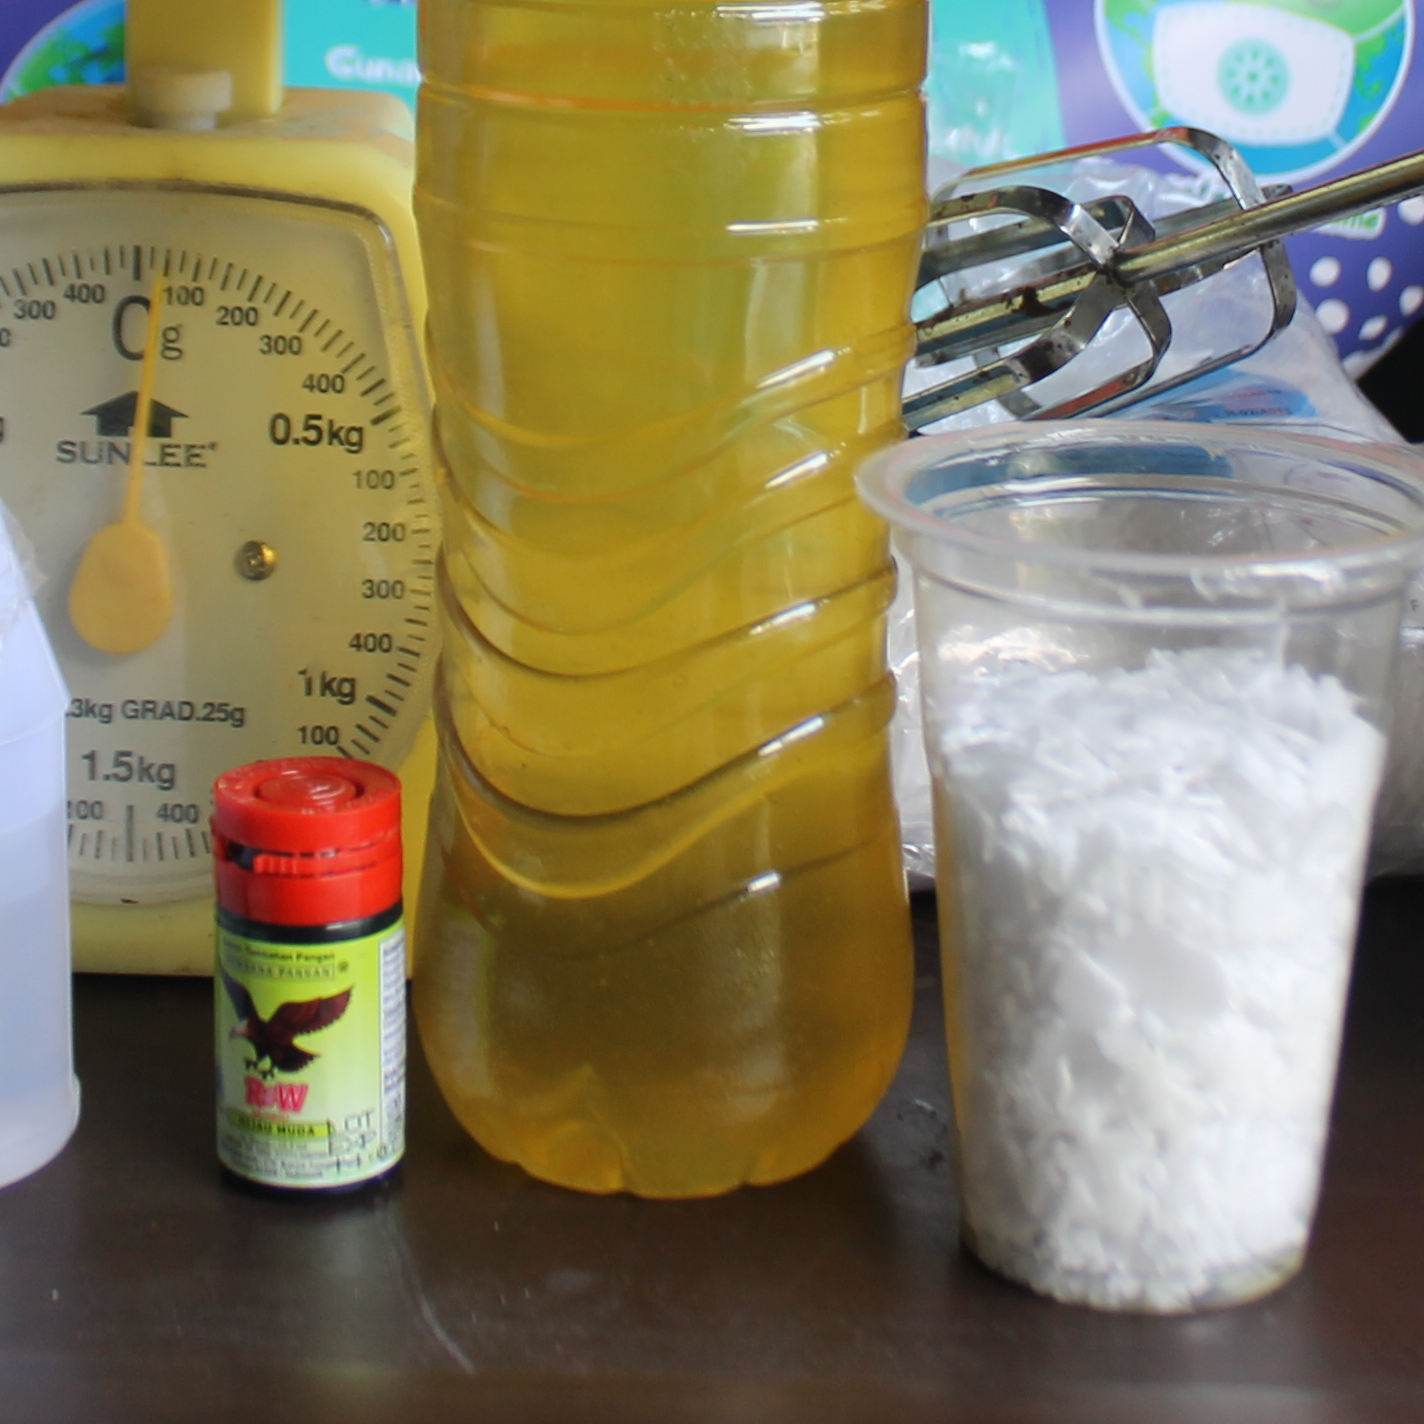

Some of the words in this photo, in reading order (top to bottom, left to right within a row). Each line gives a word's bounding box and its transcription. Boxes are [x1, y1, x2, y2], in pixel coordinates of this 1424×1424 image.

[63, 282, 106, 304] 400
[163, 284, 206, 307] 100
[13, 299, 56, 321] 300
[215, 305, 260, 327] 200
[258, 334, 304, 356] 300
[301, 373, 346, 395] 400
[268, 412, 365, 455] 0.5kg
[352, 469, 395, 490] 100
[362, 521, 406, 543] 200
[361, 579, 405, 600] 300
[348, 632, 393, 654] 400
[120, 699, 246, 728] GRAD.25g
[297, 725, 339, 746] 100
[81, 749, 176, 791] 1.5kg
[156, 802, 200, 824] 400
